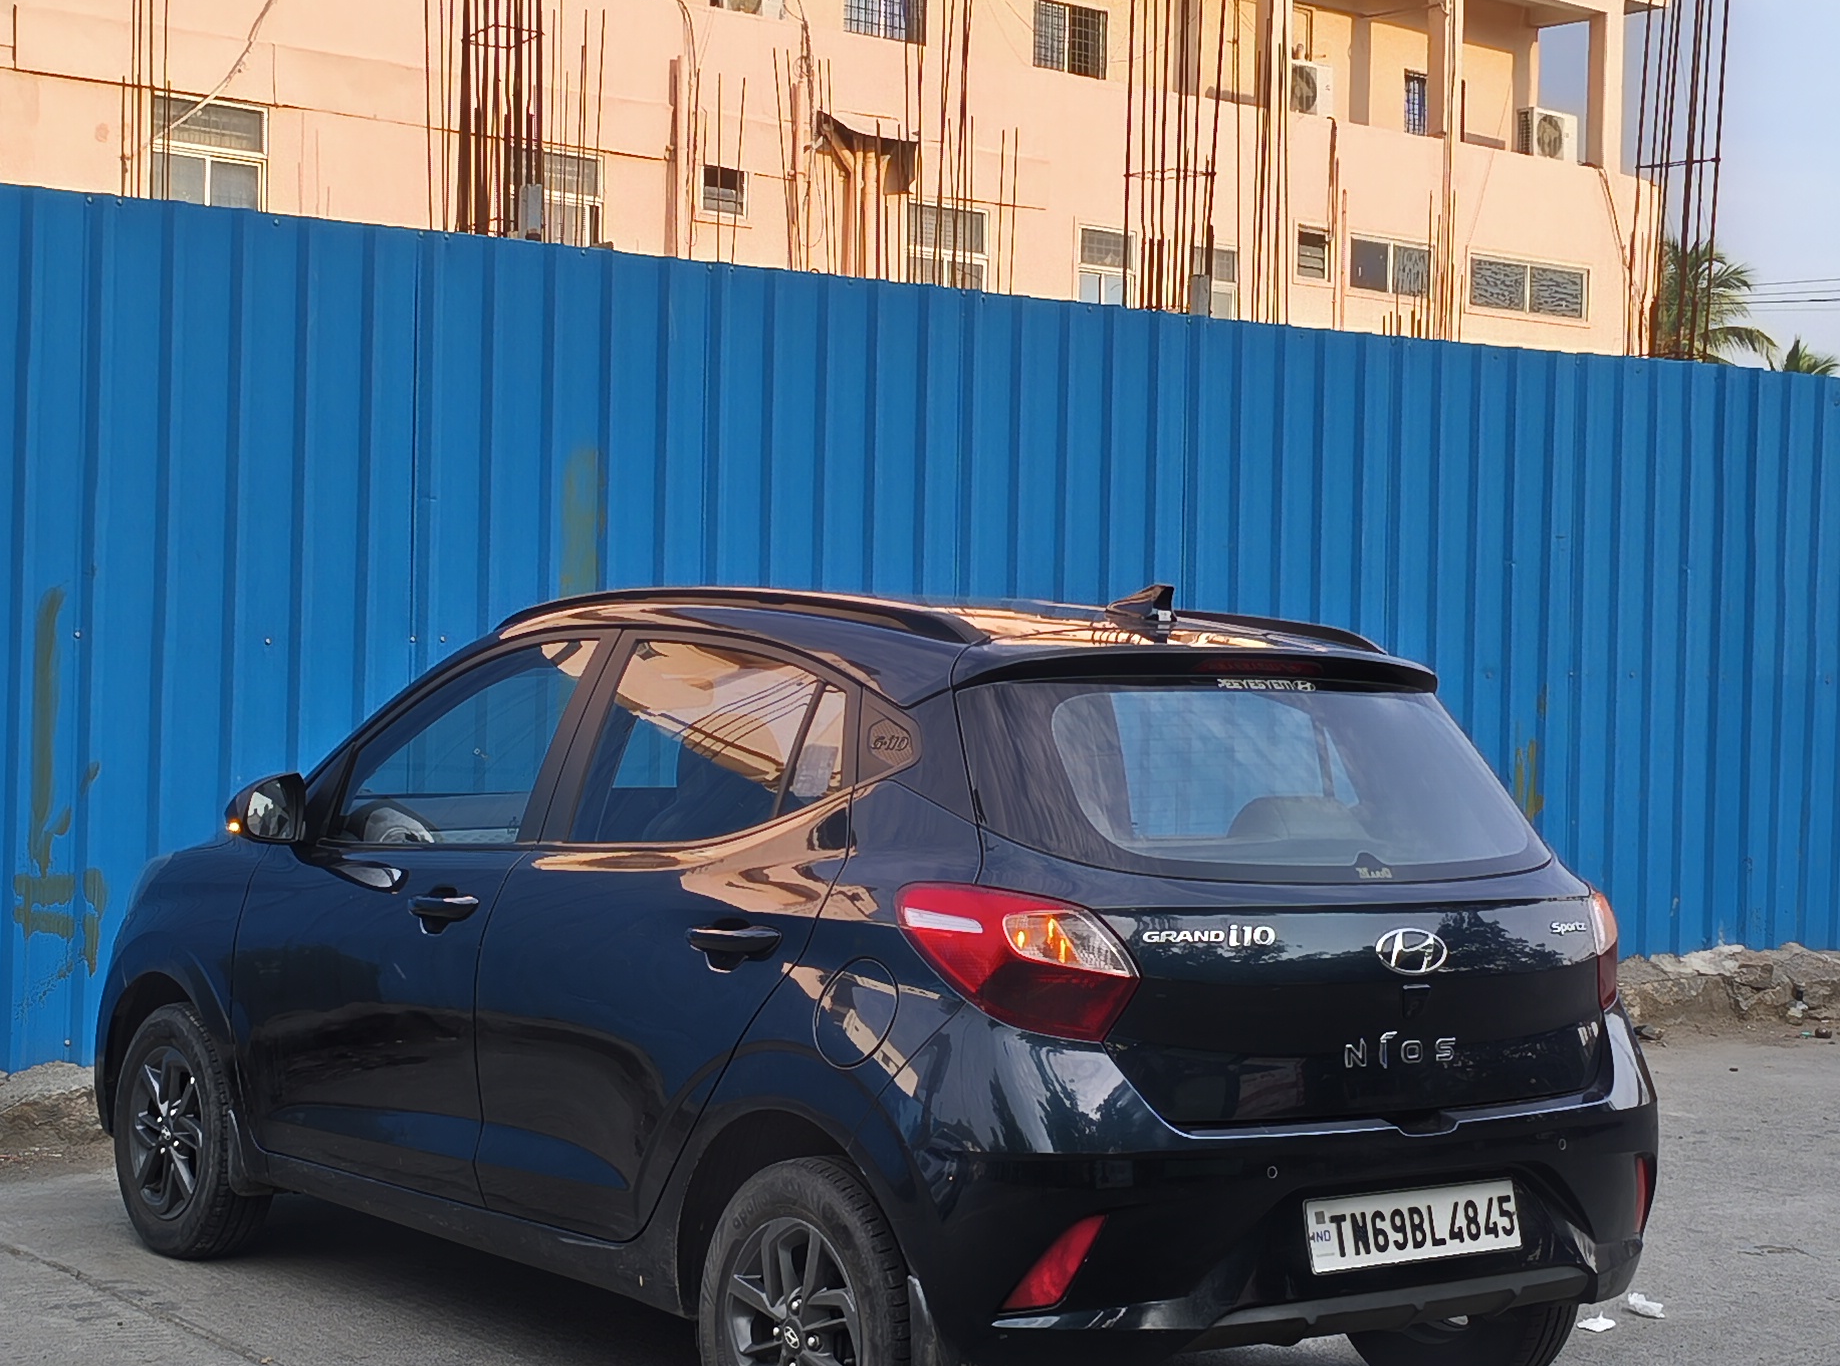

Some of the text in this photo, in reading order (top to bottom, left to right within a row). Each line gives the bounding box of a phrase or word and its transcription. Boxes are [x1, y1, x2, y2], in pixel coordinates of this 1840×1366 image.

[1142, 924, 1276, 947] GRAND i10
[1550, 921, 1587, 935] Sportz
[1330, 1195, 1515, 1257] TN69BL4845
